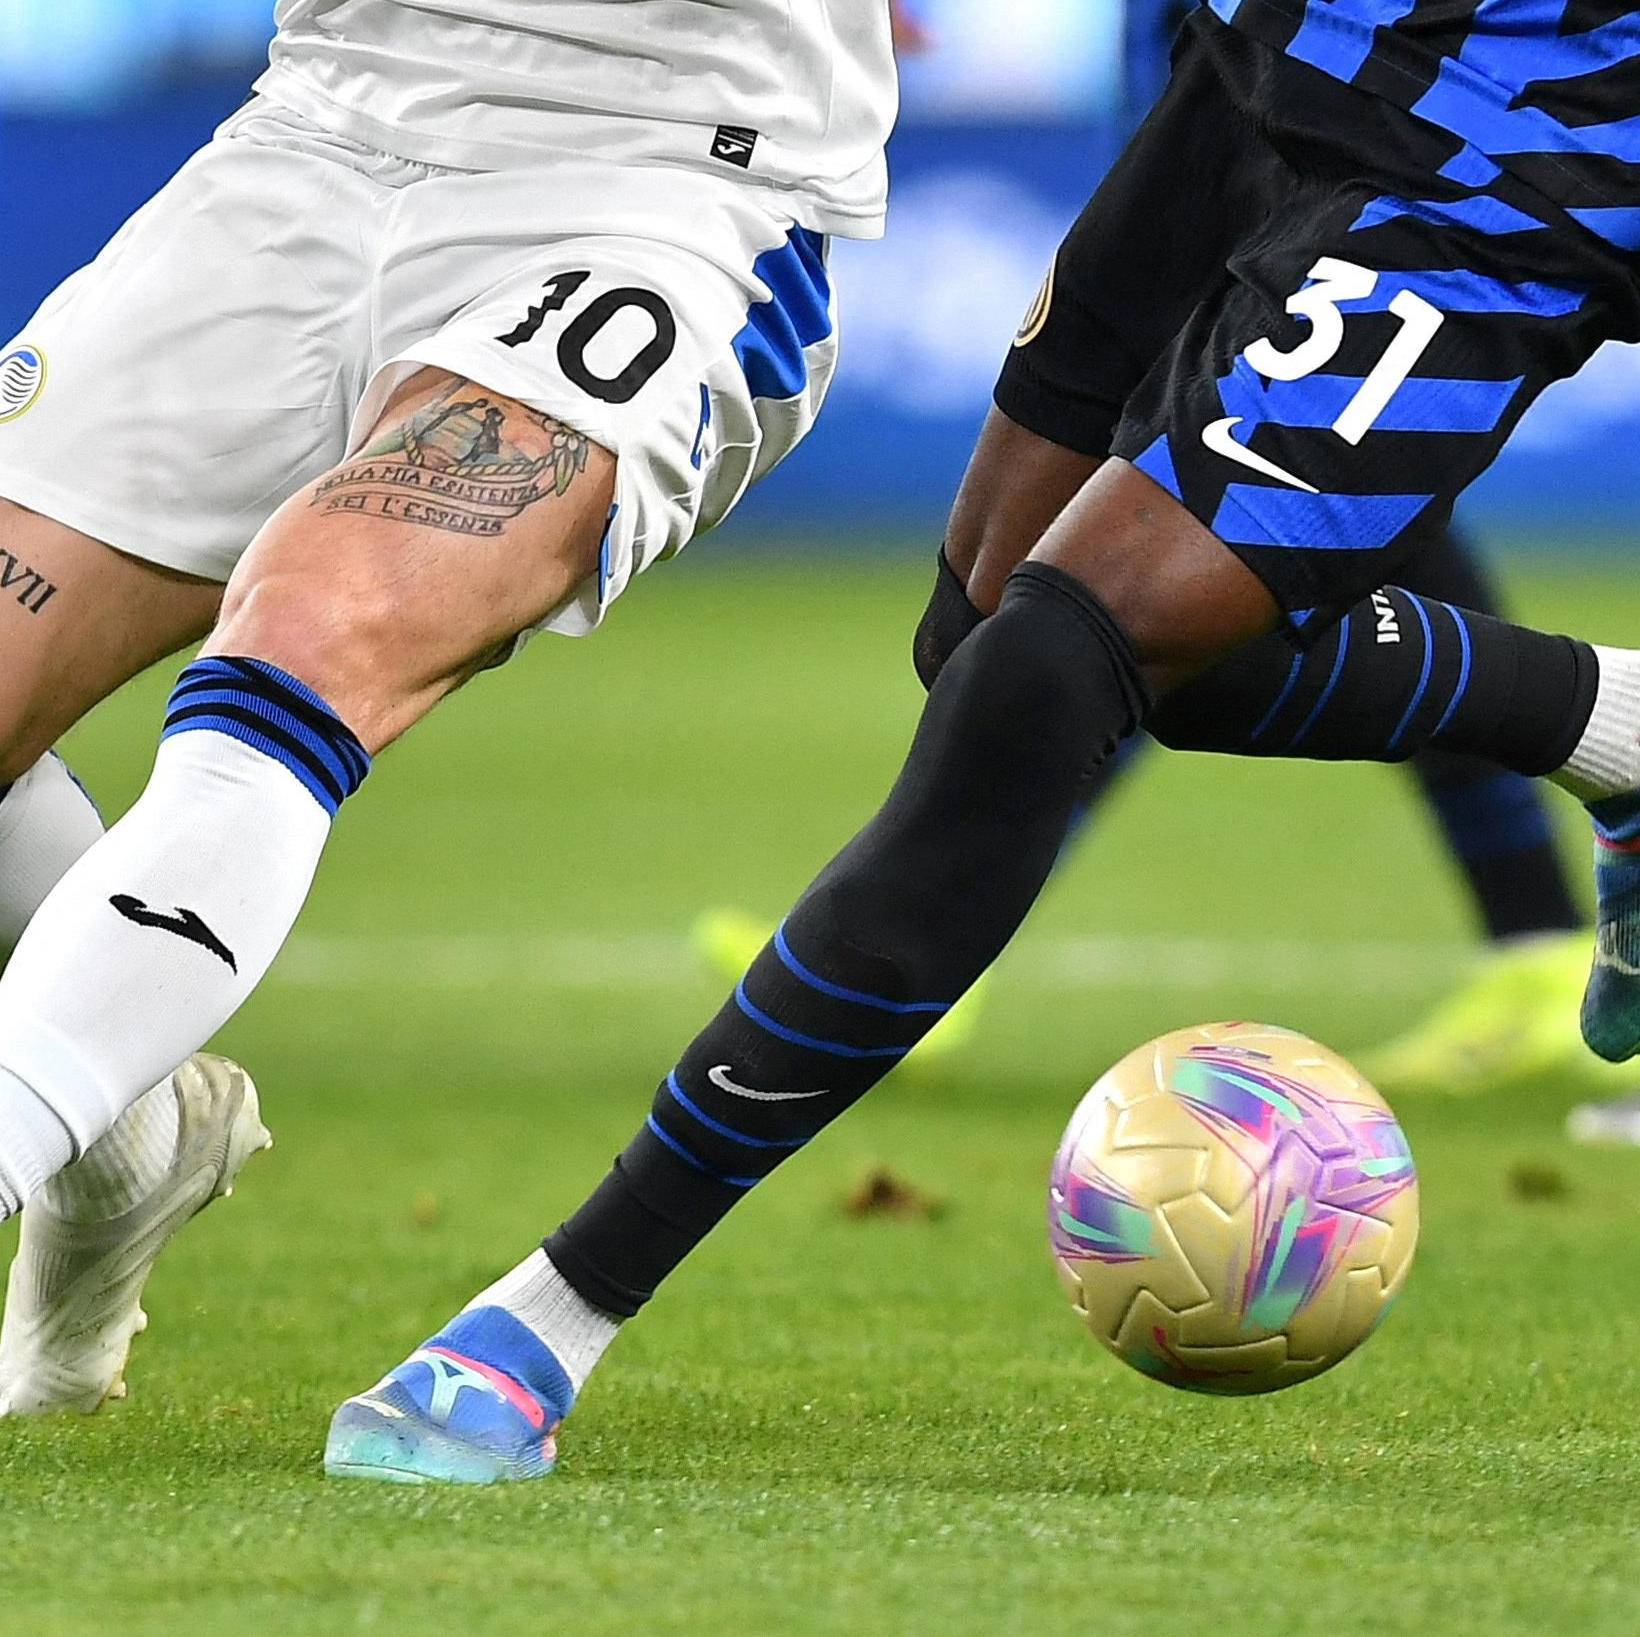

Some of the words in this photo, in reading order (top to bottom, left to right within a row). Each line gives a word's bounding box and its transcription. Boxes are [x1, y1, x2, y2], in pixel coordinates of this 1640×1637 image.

[494, 269, 676, 405] 10
[1243, 256, 1445, 446] 31
[327, 496, 366, 510] SEI
[380, 466, 421, 485] MIA
[1370, 588, 1401, 644] INT
